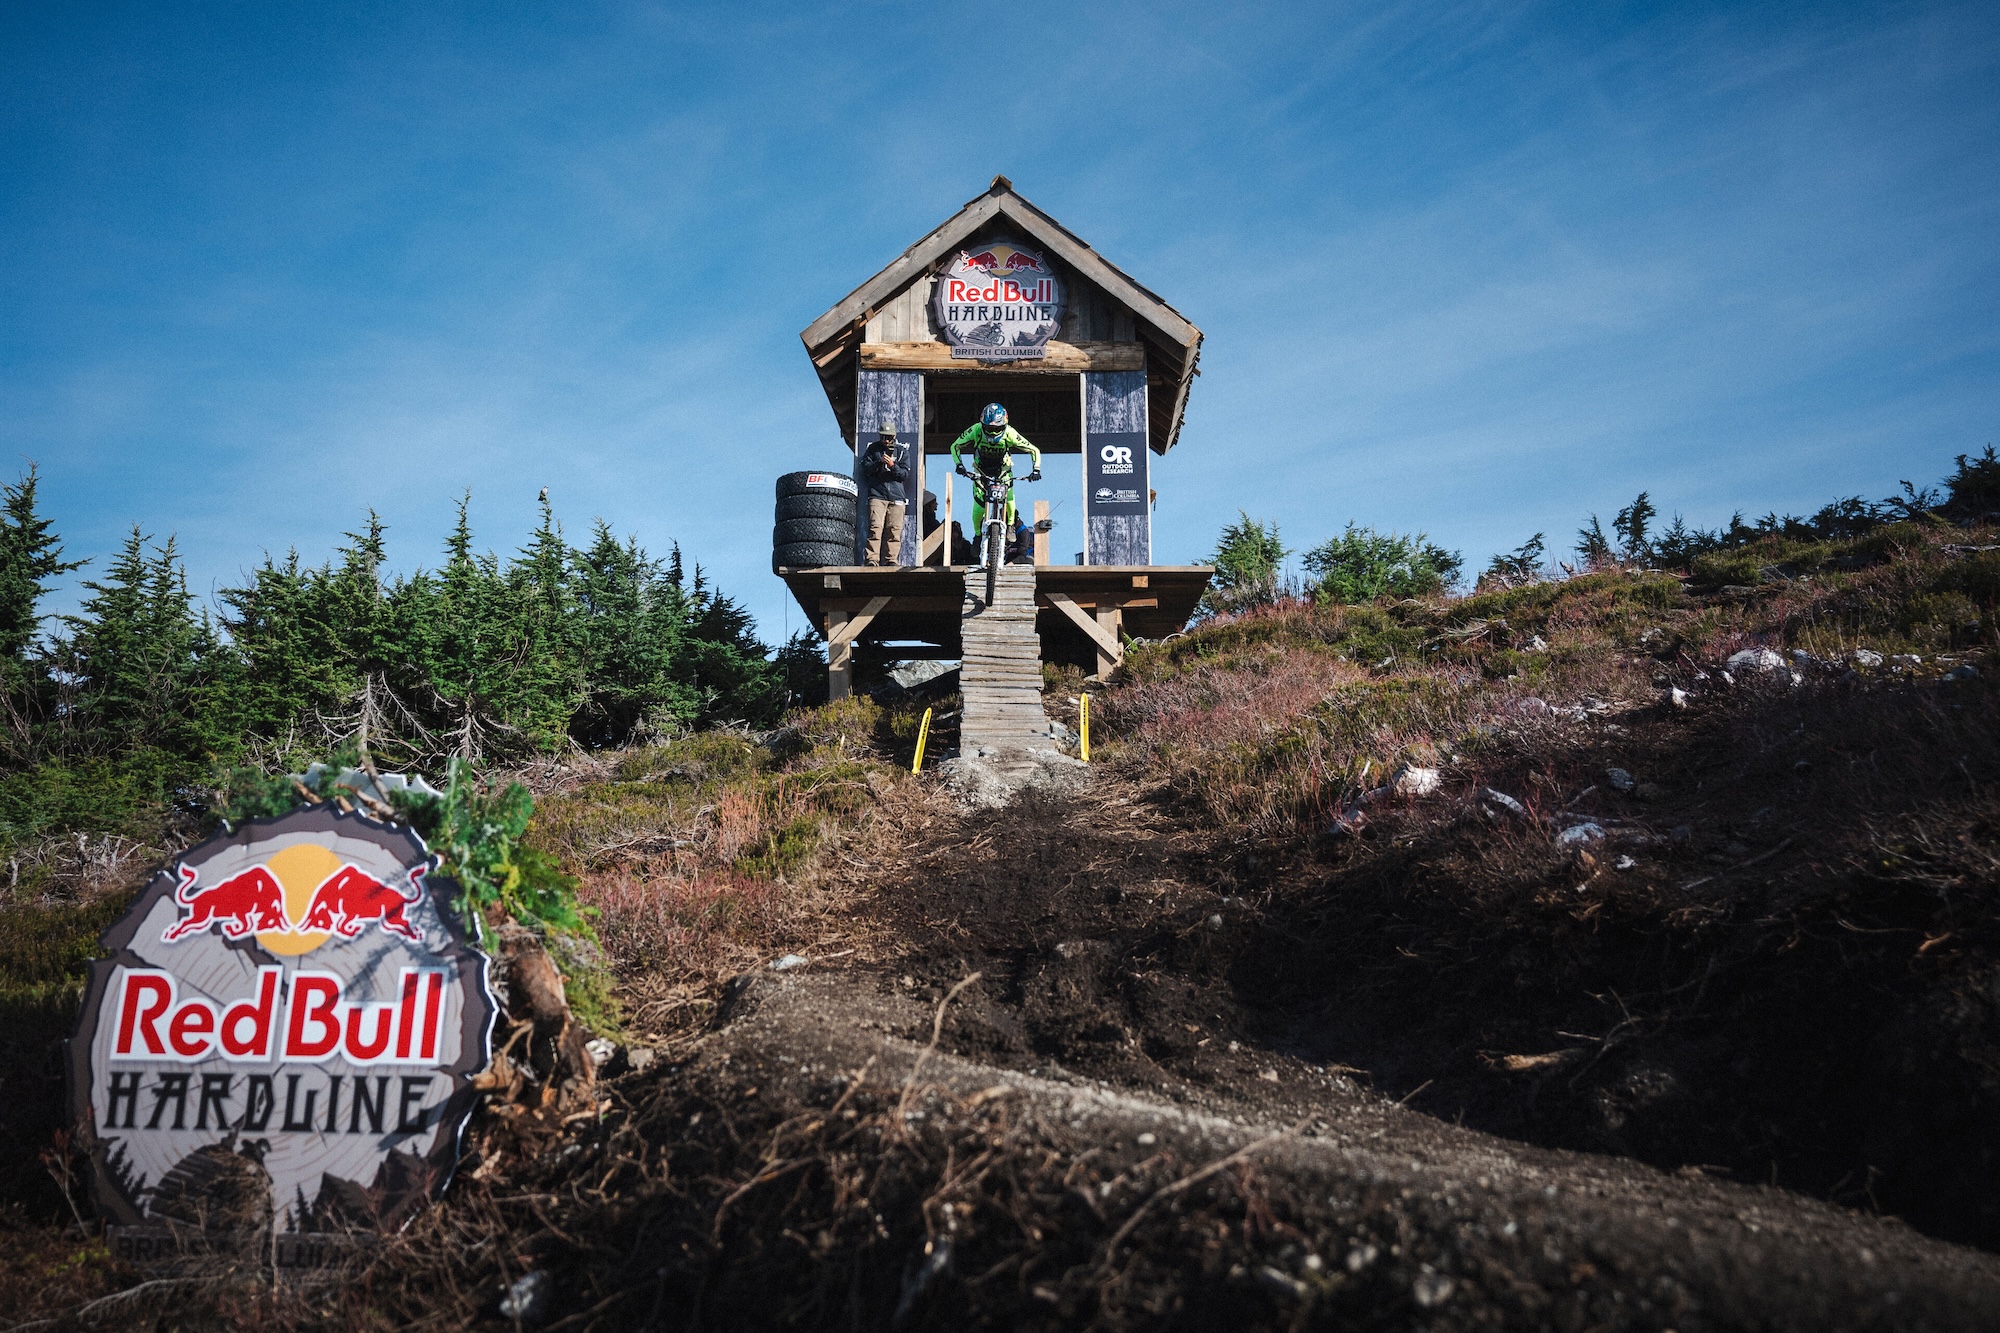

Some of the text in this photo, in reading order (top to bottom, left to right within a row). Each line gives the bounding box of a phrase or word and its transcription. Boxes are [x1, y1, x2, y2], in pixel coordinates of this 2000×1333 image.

[950, 279, 1052, 302] Red Bull
[949, 306, 1052, 321] HARDLINE
[955, 348, 1043, 356] BRITISH COLUMBIA
[1101, 445, 1133, 464] OR
[116, 971, 443, 1060] Red Bull
[103, 1071, 434, 1134] HARDLINE
